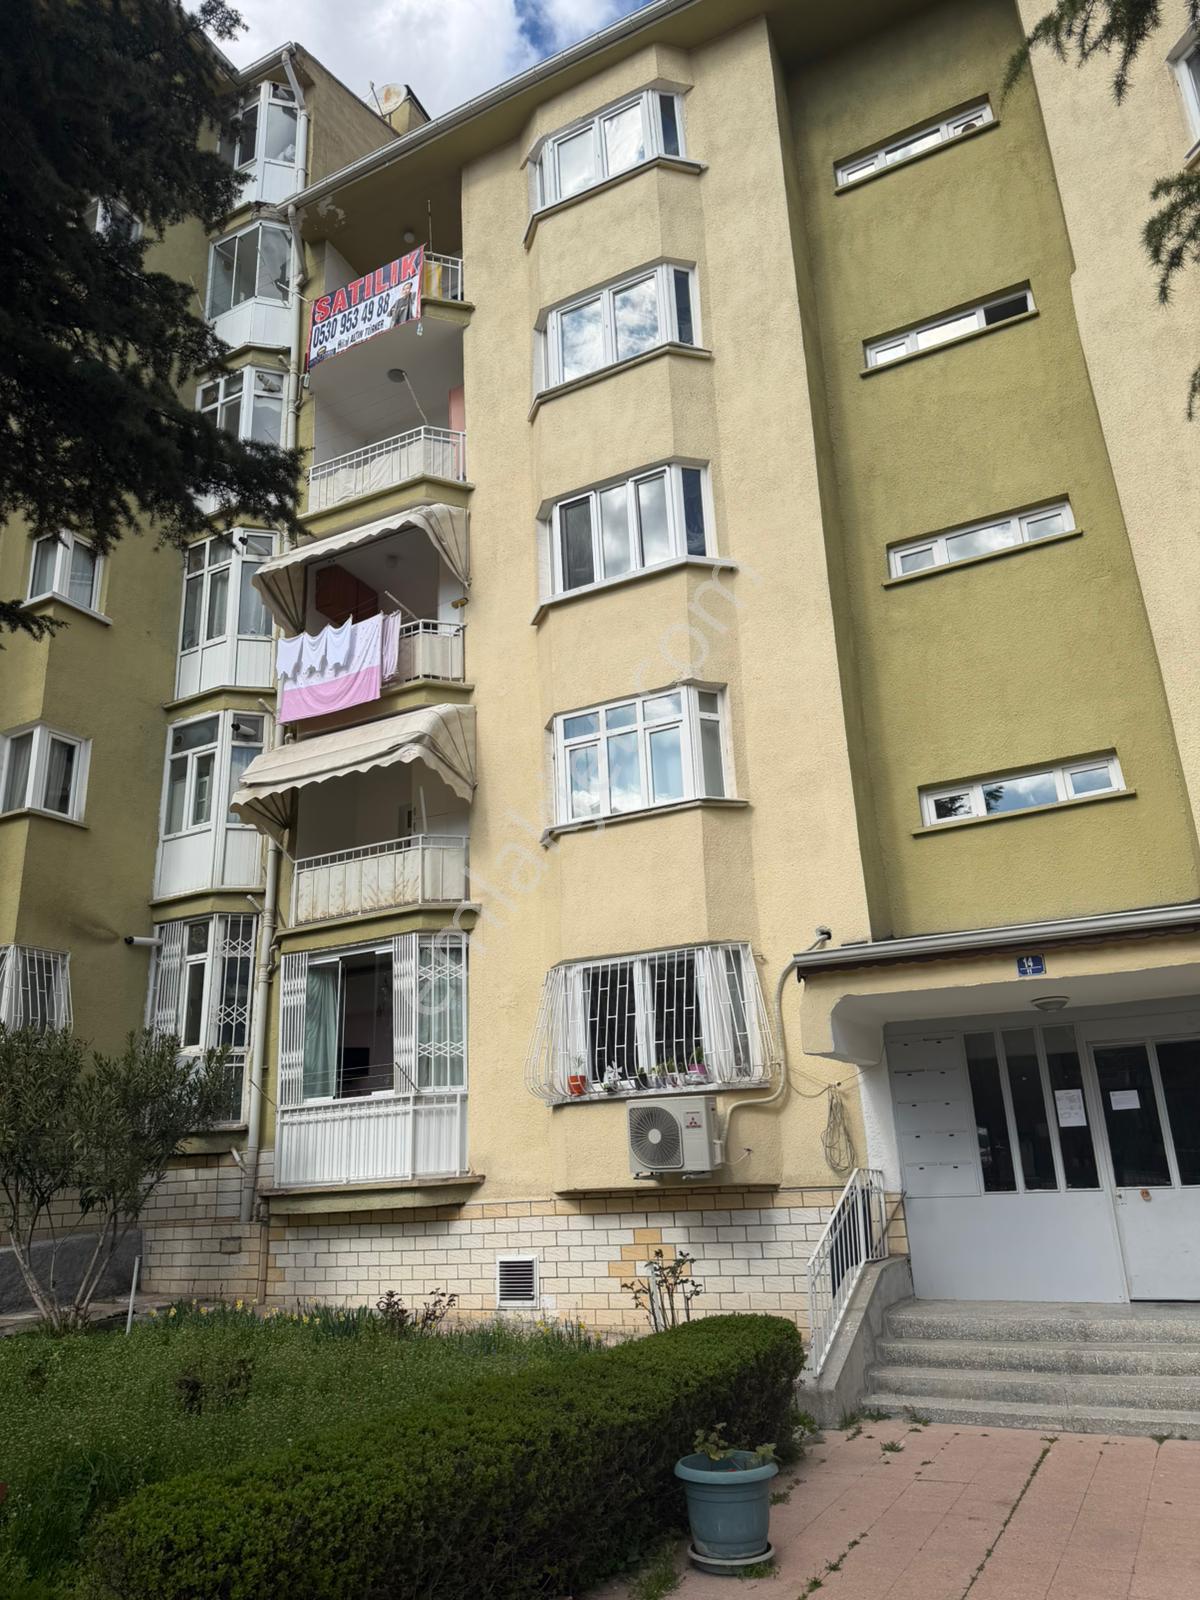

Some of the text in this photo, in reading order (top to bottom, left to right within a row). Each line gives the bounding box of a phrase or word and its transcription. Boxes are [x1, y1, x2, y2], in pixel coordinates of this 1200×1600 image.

[315, 250, 419, 321] SATILIK
[312, 292, 391, 348] 0530 953 49 88
[1023, 957, 1033, 968] 14
